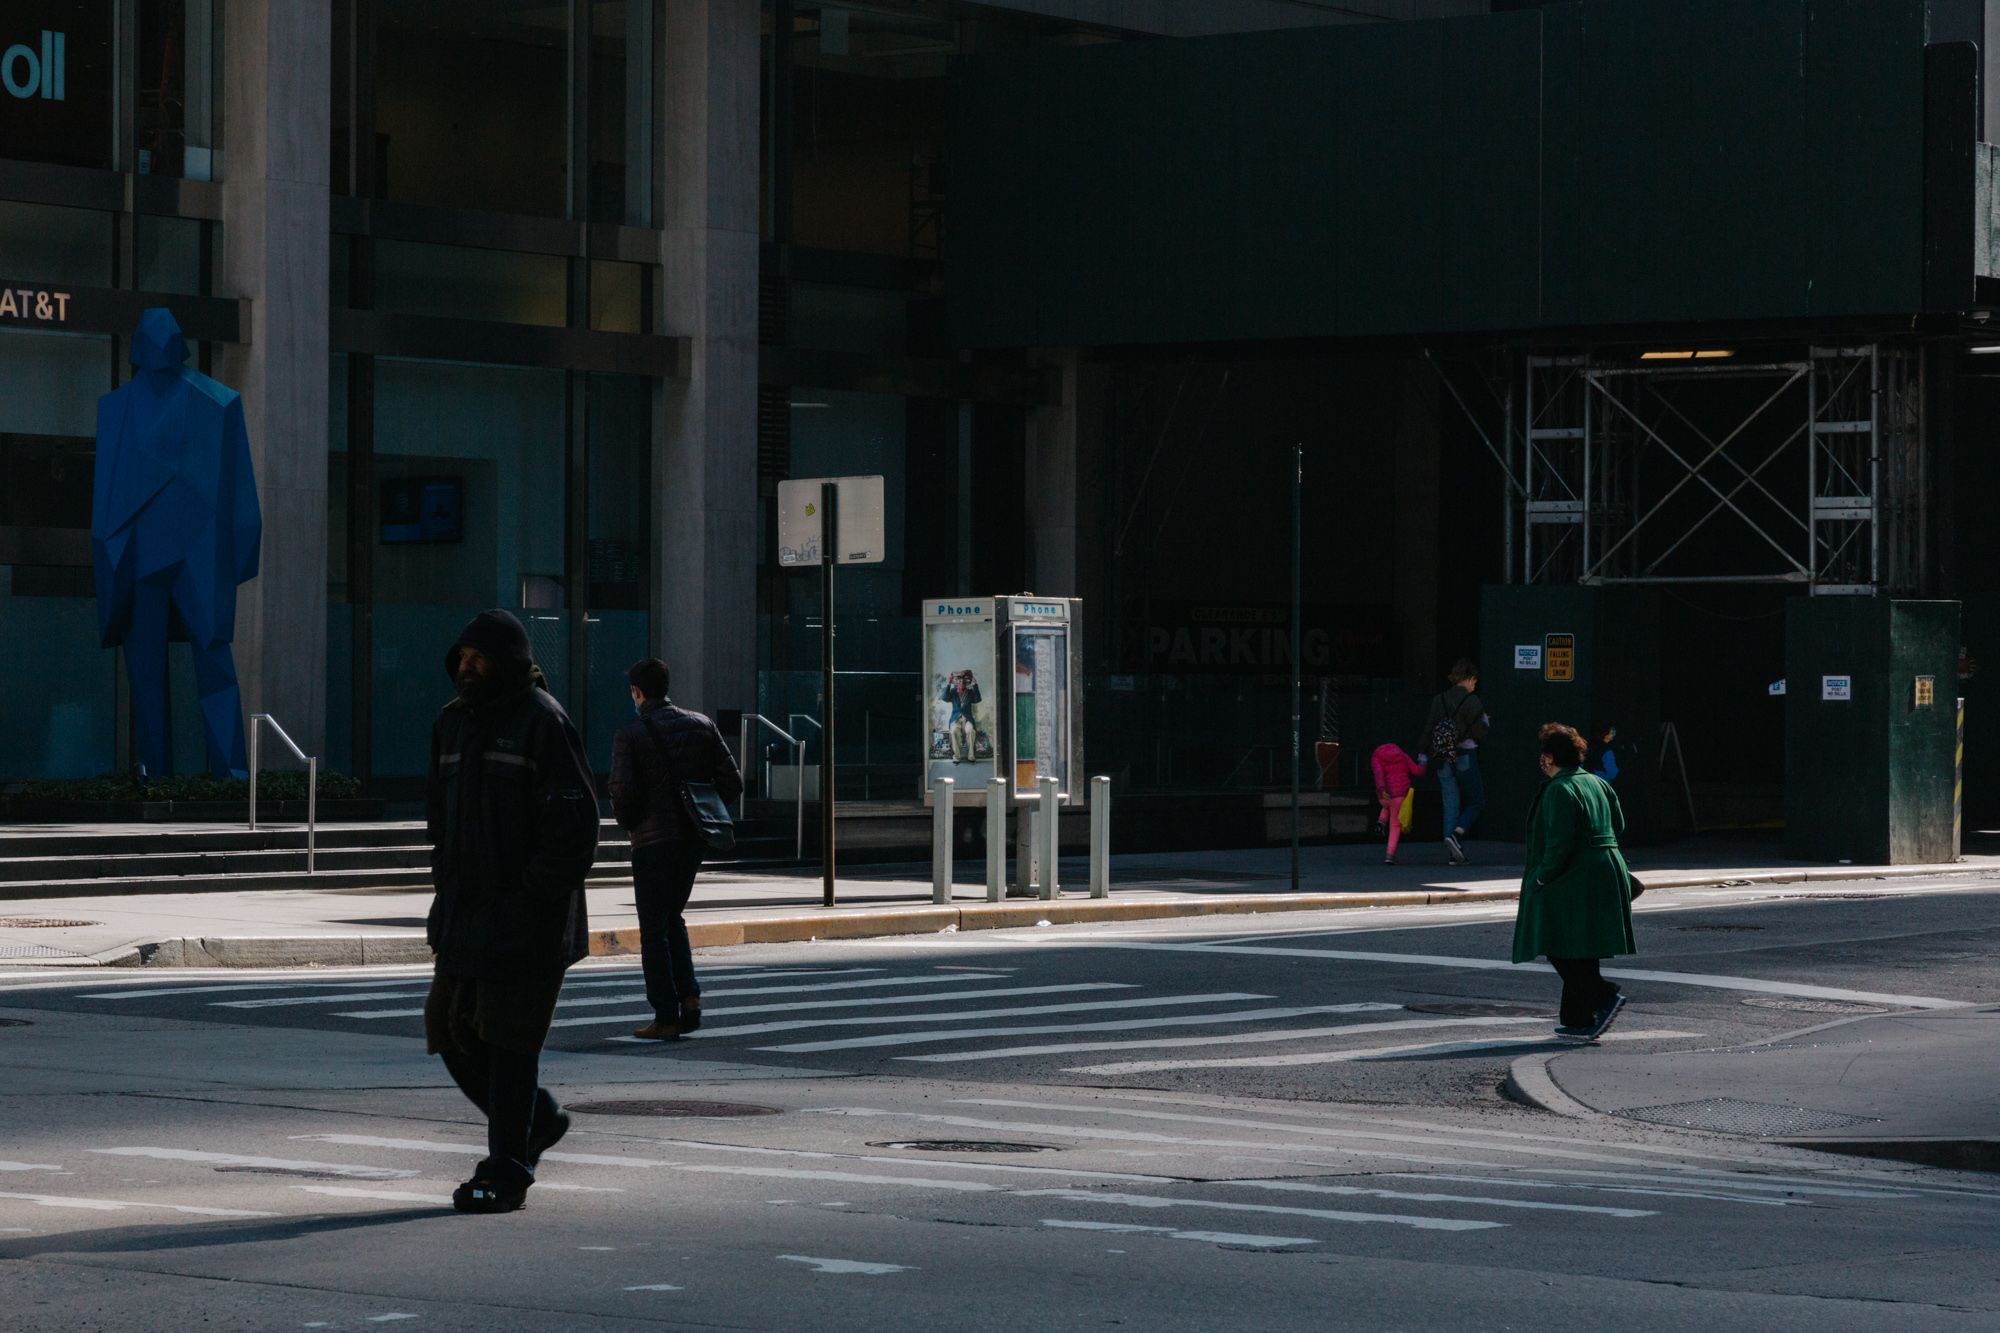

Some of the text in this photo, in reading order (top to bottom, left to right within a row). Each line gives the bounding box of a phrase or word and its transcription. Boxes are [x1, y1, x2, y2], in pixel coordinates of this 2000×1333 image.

[1, 29, 66, 101] oll
[0, 287, 72, 322] AT&T
[938, 604, 981, 615] Phone
[1023, 602, 1056, 614] Phone
[1149, 625, 1330, 665] PARKING
